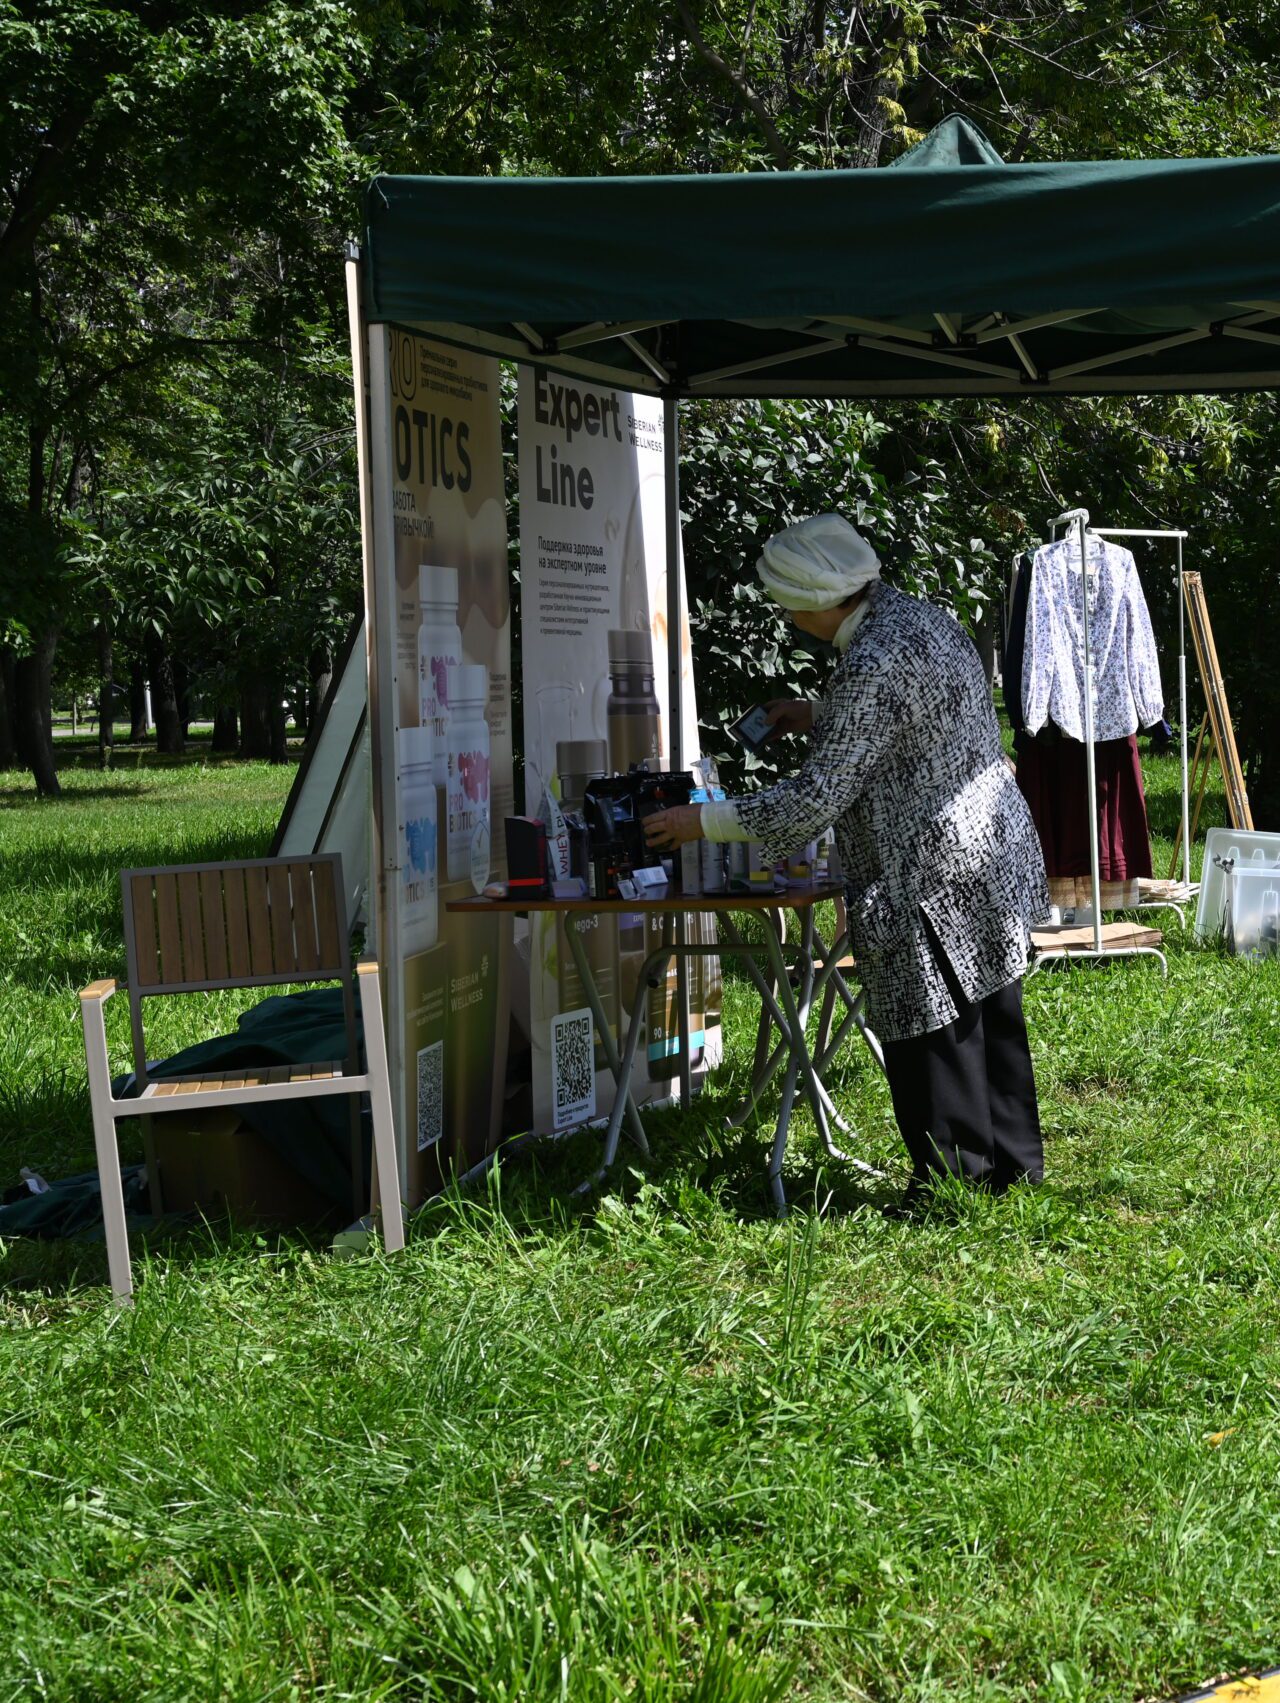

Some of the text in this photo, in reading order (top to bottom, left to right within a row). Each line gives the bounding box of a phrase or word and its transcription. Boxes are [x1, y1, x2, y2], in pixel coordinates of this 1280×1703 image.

[535, 369, 623, 443] Expert
[627, 415, 656, 434] SIBERIAN
[629, 431, 663, 453] WELLNESS
[536, 443, 594, 511] Line
[538, 536, 604, 559] Поддержка здоровья
[538, 557, 607, 576] на экспертном уровне
[449, 793, 464, 811] PRO
[554, 833, 569, 875] WHEY
[450, 971, 479, 993] SIBERIAN
[450, 989, 483, 1013] WELLNESS
[653, 1026, 662, 1039] 90
